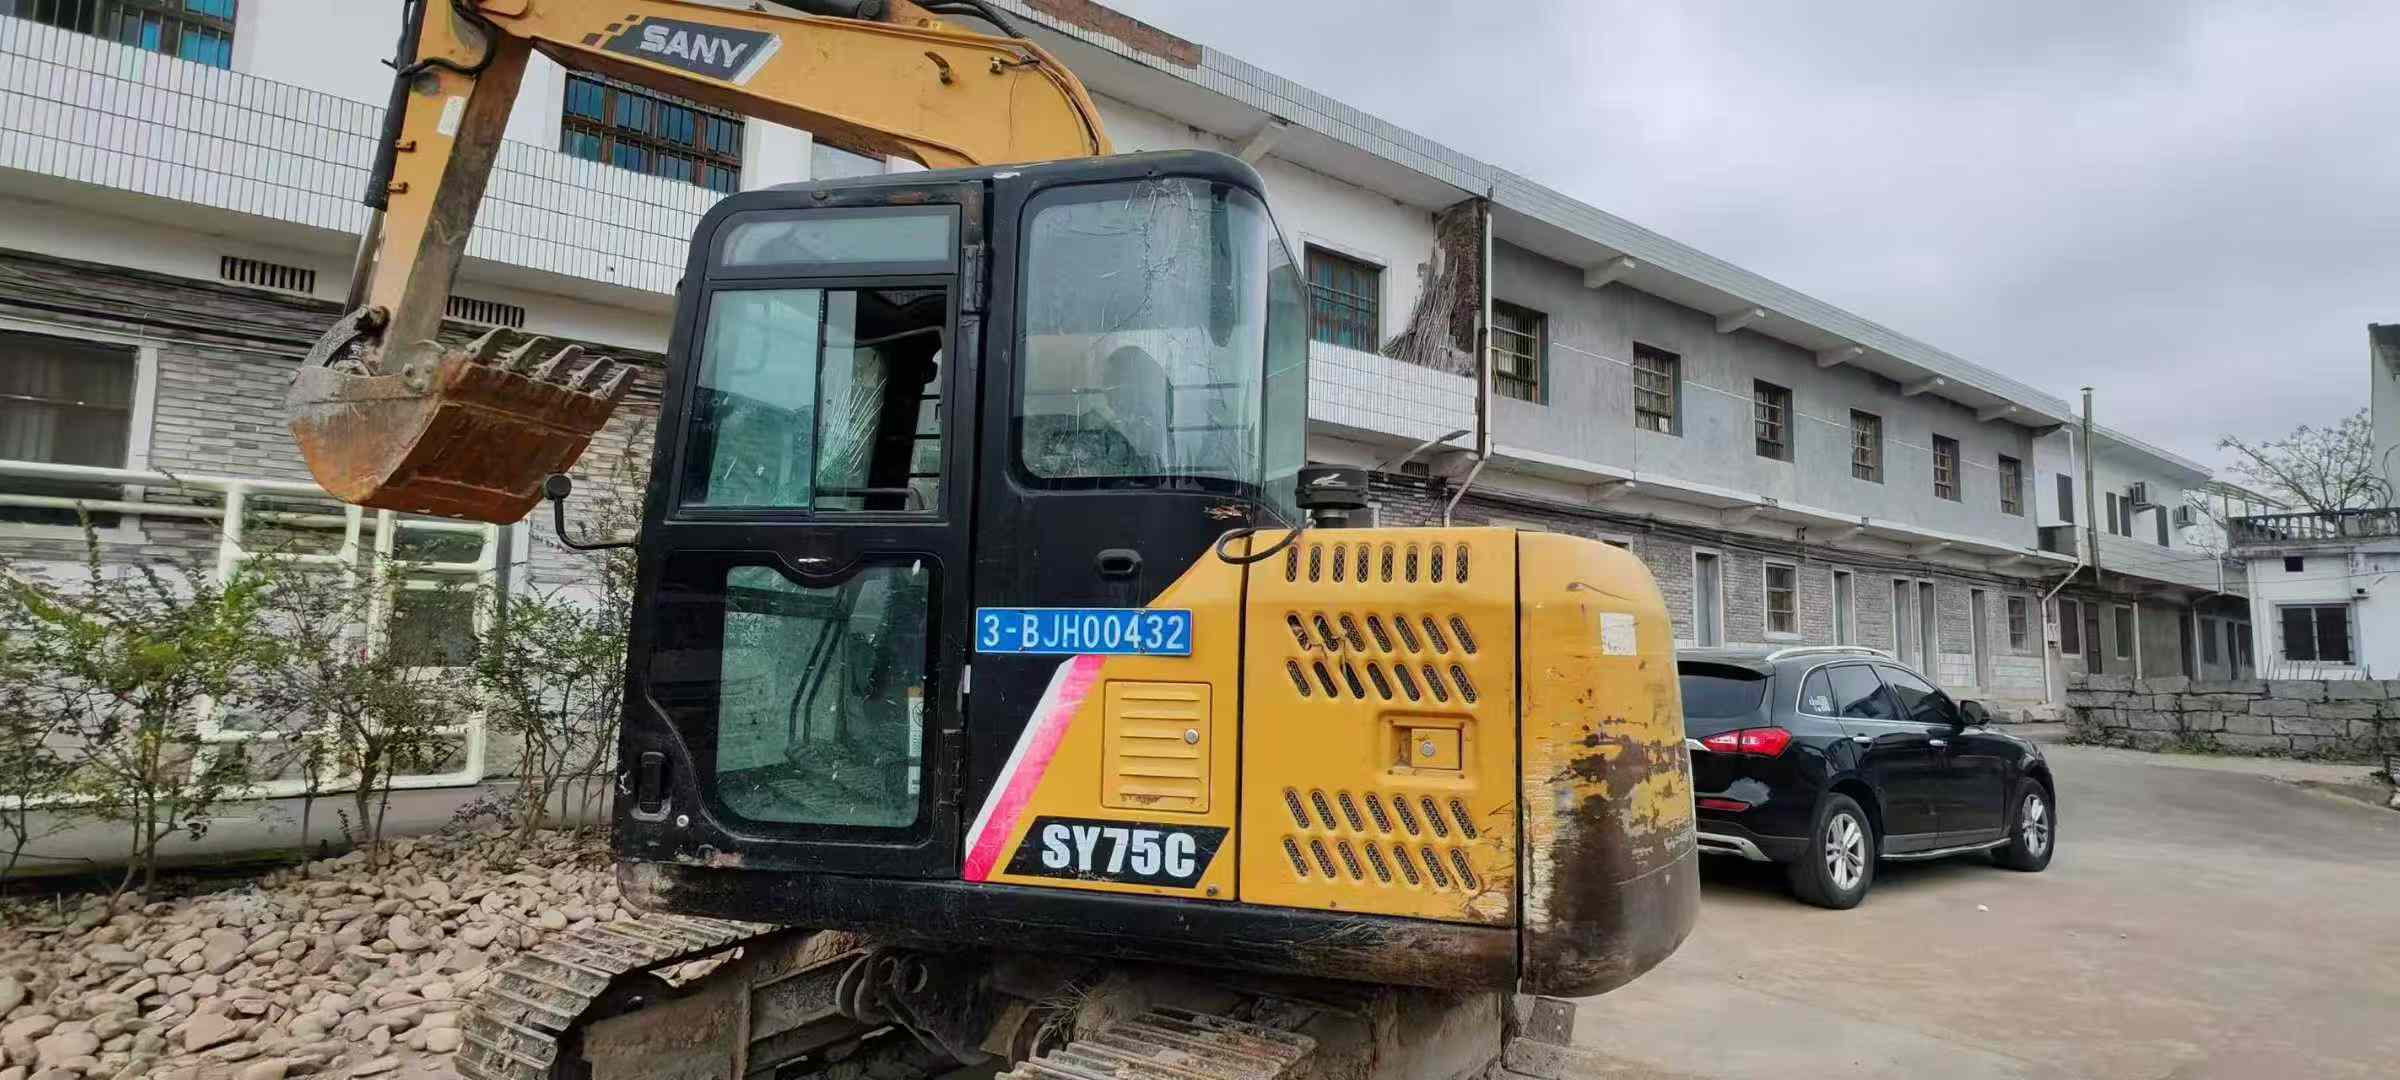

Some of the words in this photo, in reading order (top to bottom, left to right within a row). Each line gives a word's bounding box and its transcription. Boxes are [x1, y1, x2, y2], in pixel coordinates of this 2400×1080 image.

[639, 24, 749, 68] SANY
[983, 614, 1185, 650] 3-BJH00432
[1042, 823, 1196, 878] SY75C
